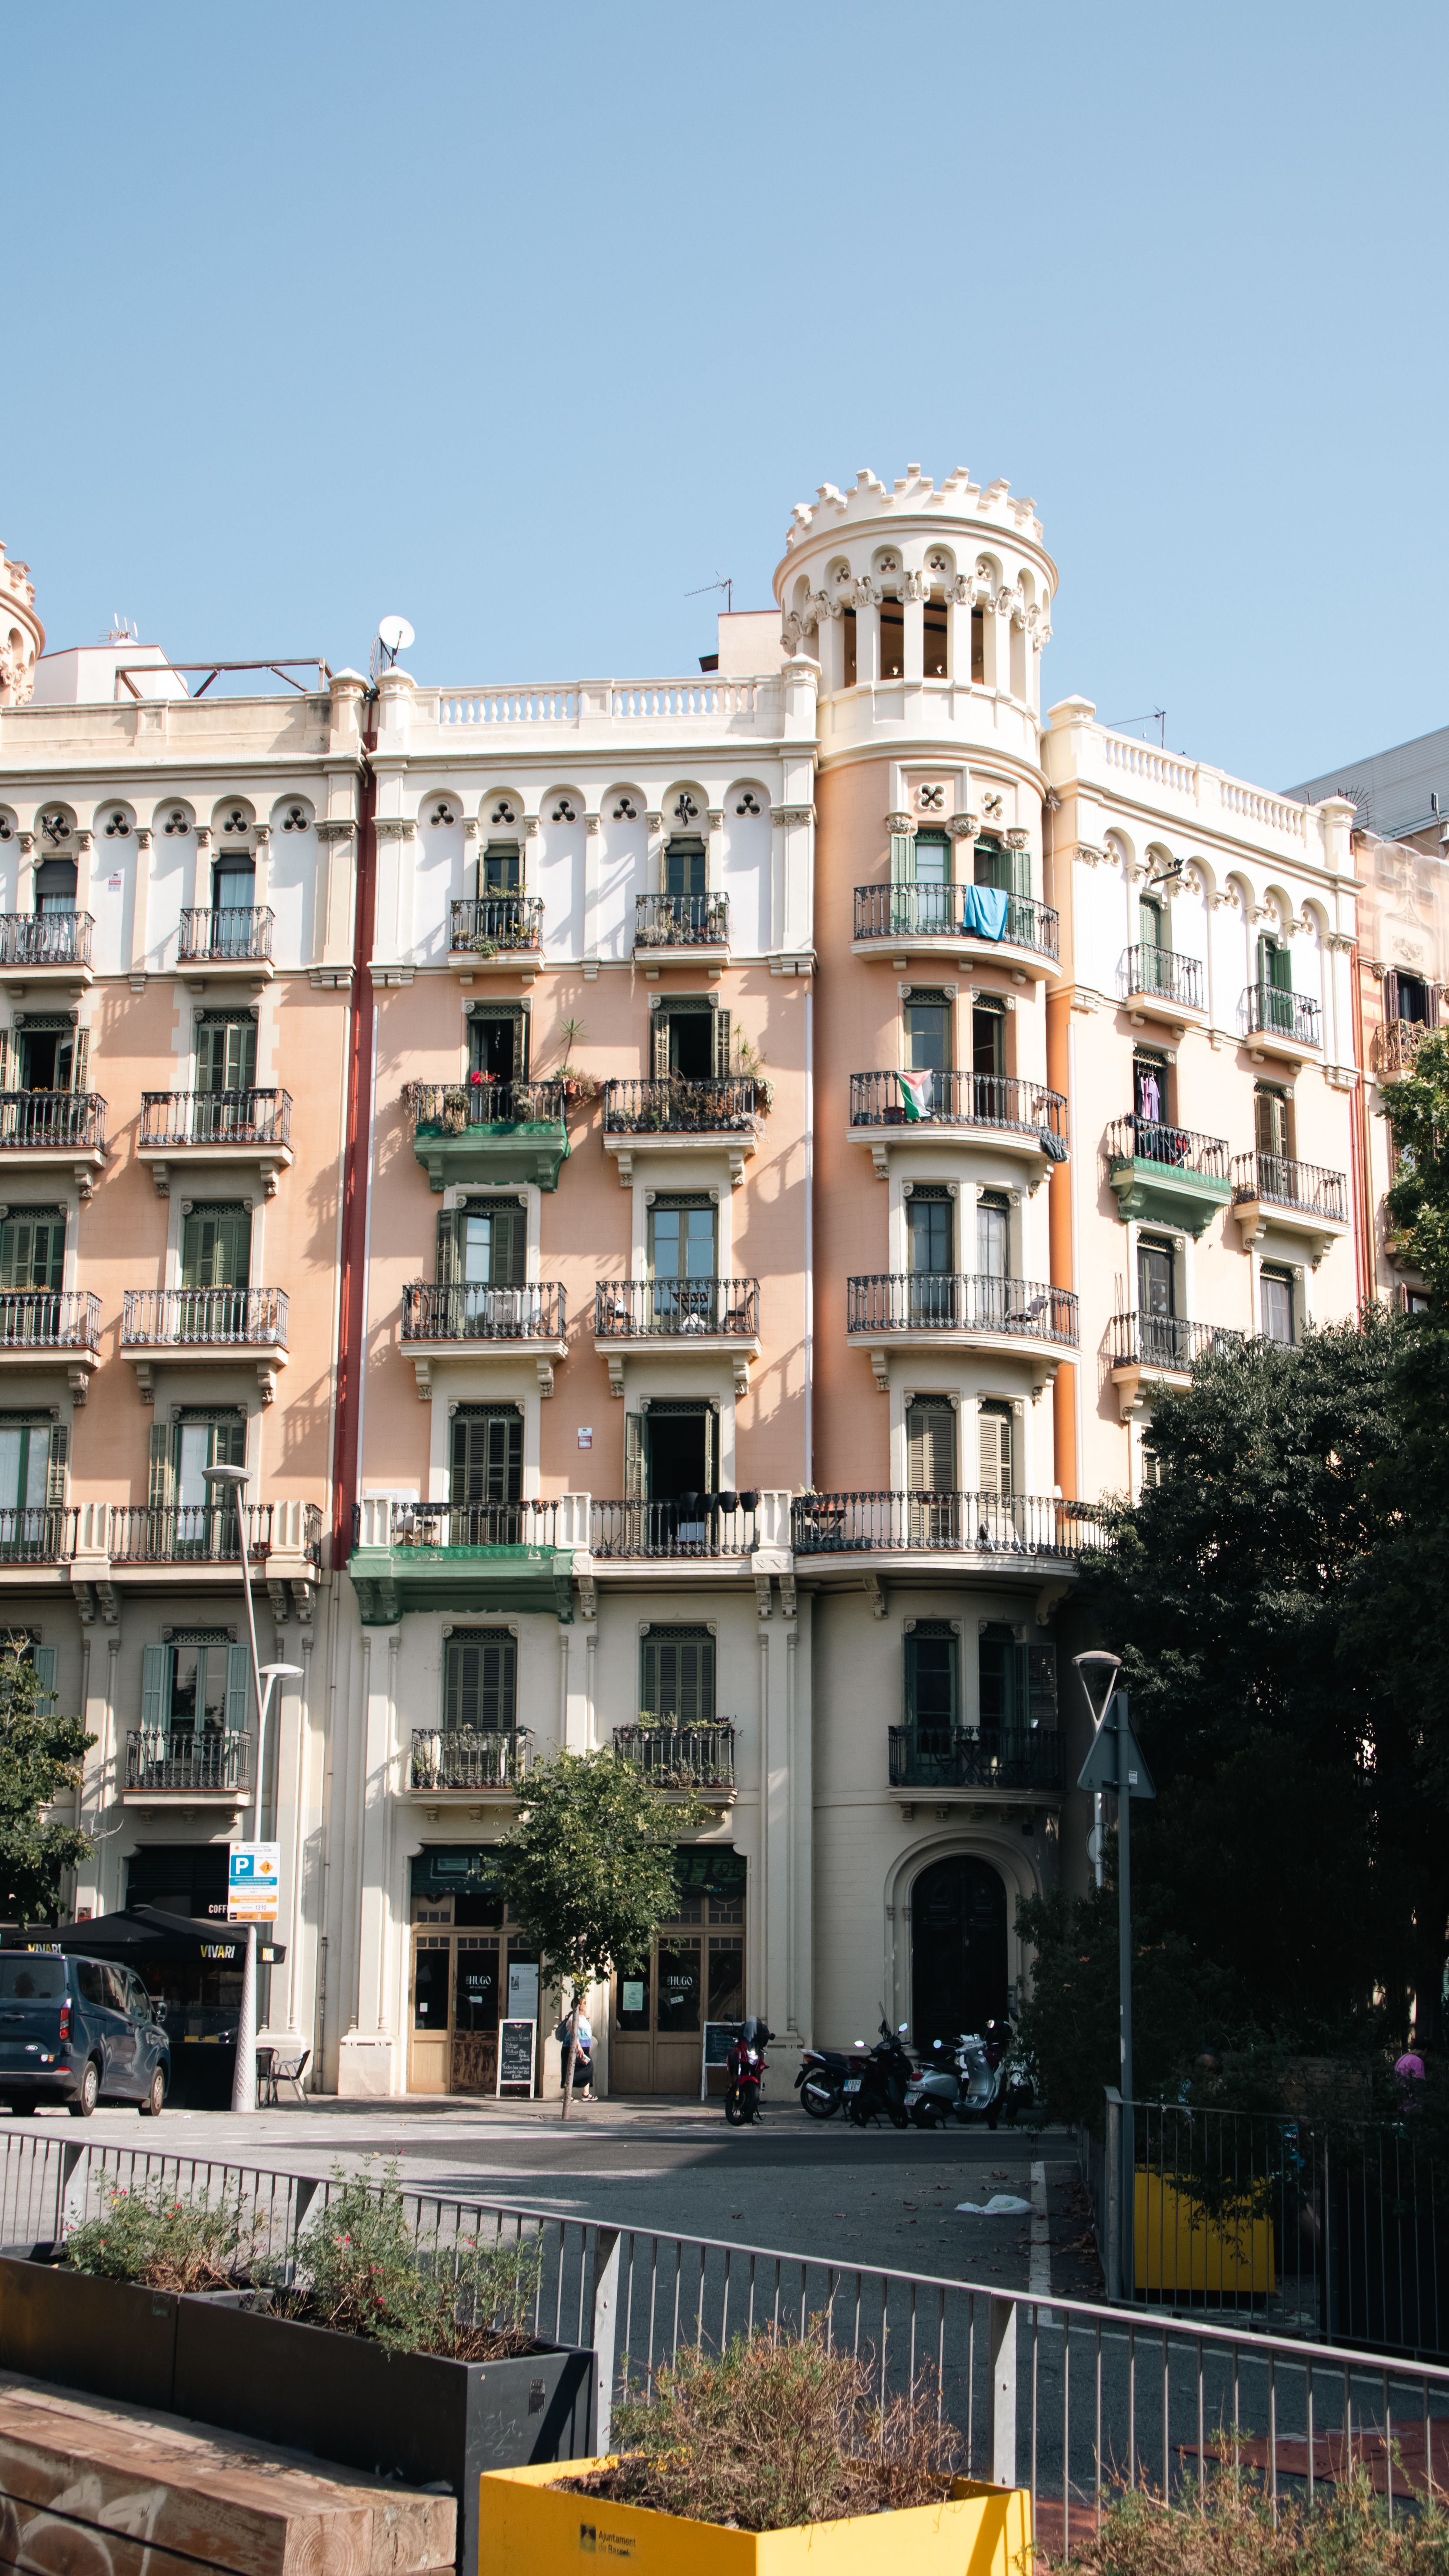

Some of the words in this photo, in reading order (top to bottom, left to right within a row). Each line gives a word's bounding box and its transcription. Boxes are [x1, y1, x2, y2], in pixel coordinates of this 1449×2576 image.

[236, 1857, 249, 1875] P
[209, 1905, 227, 1913] COFF
[200, 1945, 236, 1959] VIVARI
[469, 1975, 491, 1985] HUGO
[671, 1976, 693, 1985] HUGO
[598, 2530, 636, 2548] Ajuntament
[598, 2543, 607, 2553] de
